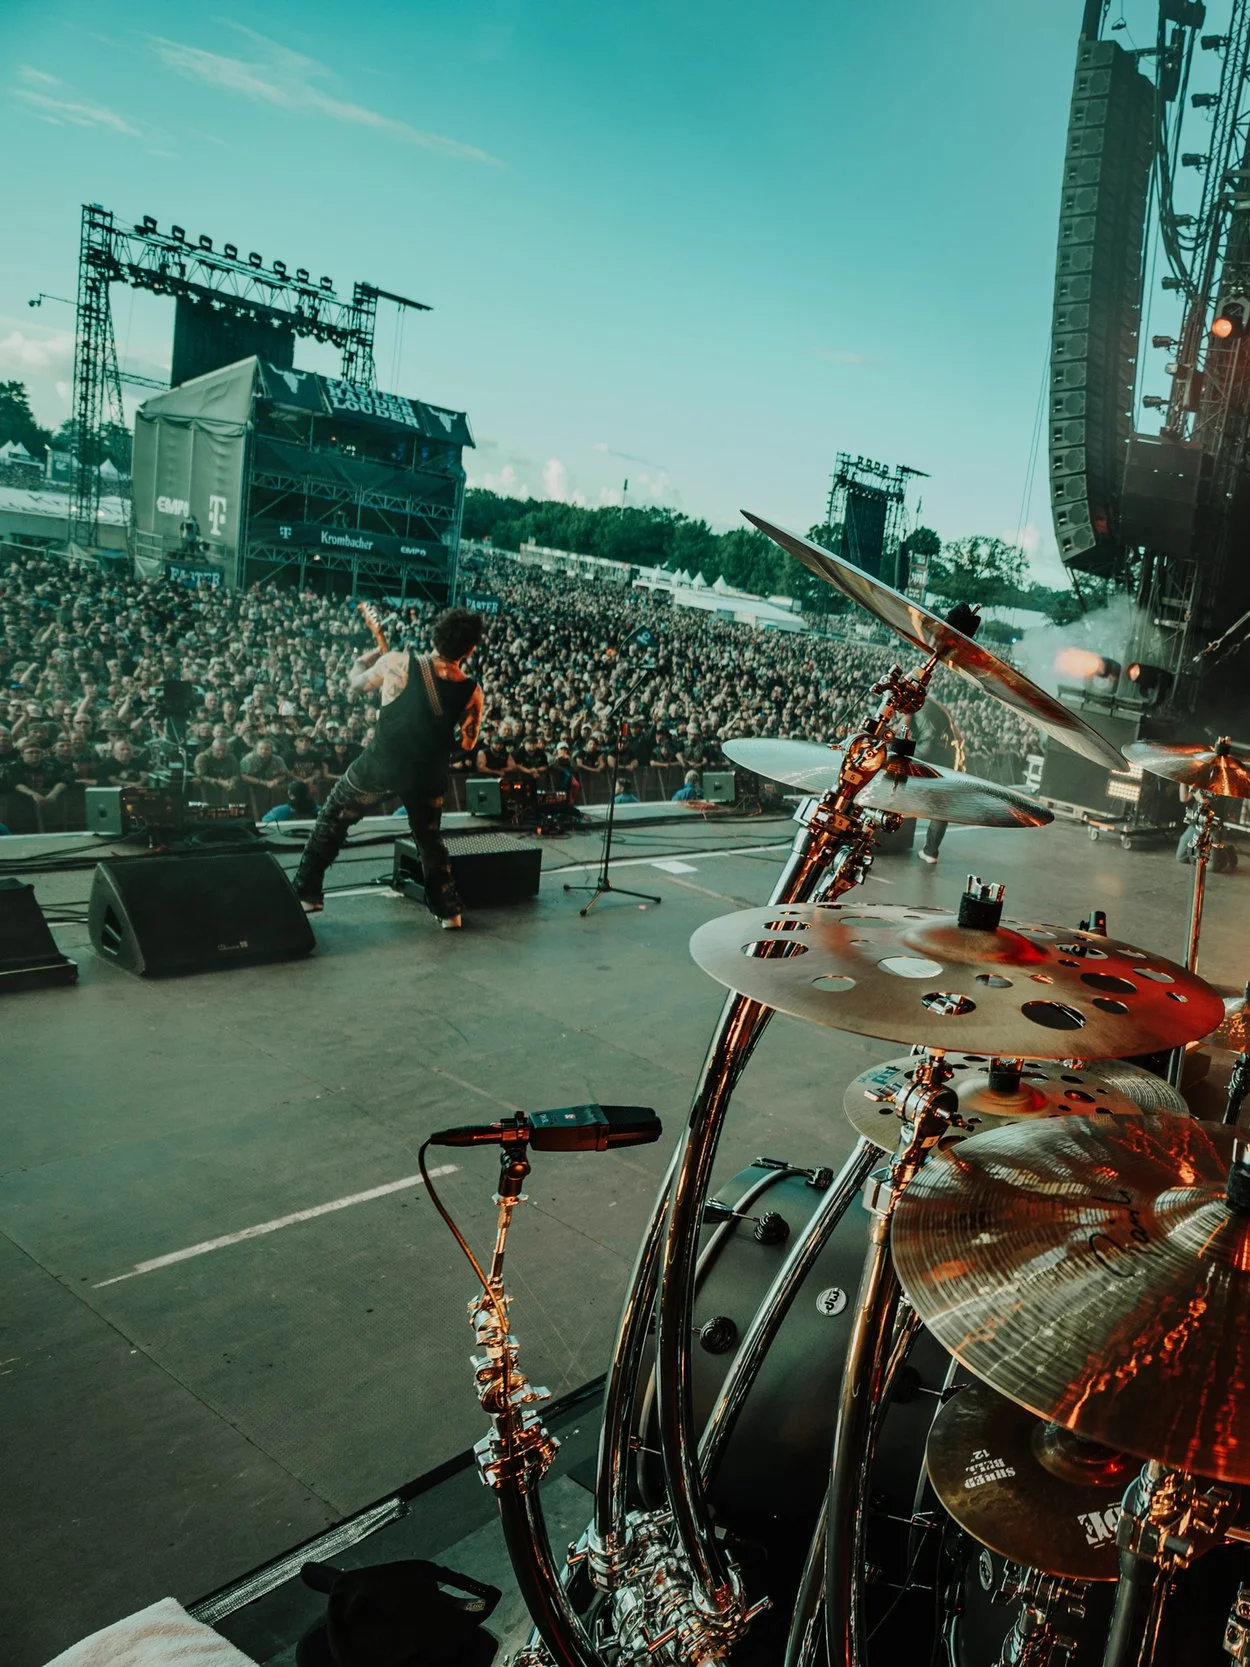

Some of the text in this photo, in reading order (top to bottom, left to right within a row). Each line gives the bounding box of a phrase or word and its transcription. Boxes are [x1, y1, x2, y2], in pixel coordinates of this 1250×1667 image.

[326, 377, 412, 406] FASTER
[328, 386, 415, 417] HARDER
[331, 397, 420, 429] LOUDER
[321, 531, 373, 550] Krombacher
[964, 1467, 1016, 1489] SHRED
[965, 1458, 1005, 1475] BELL
